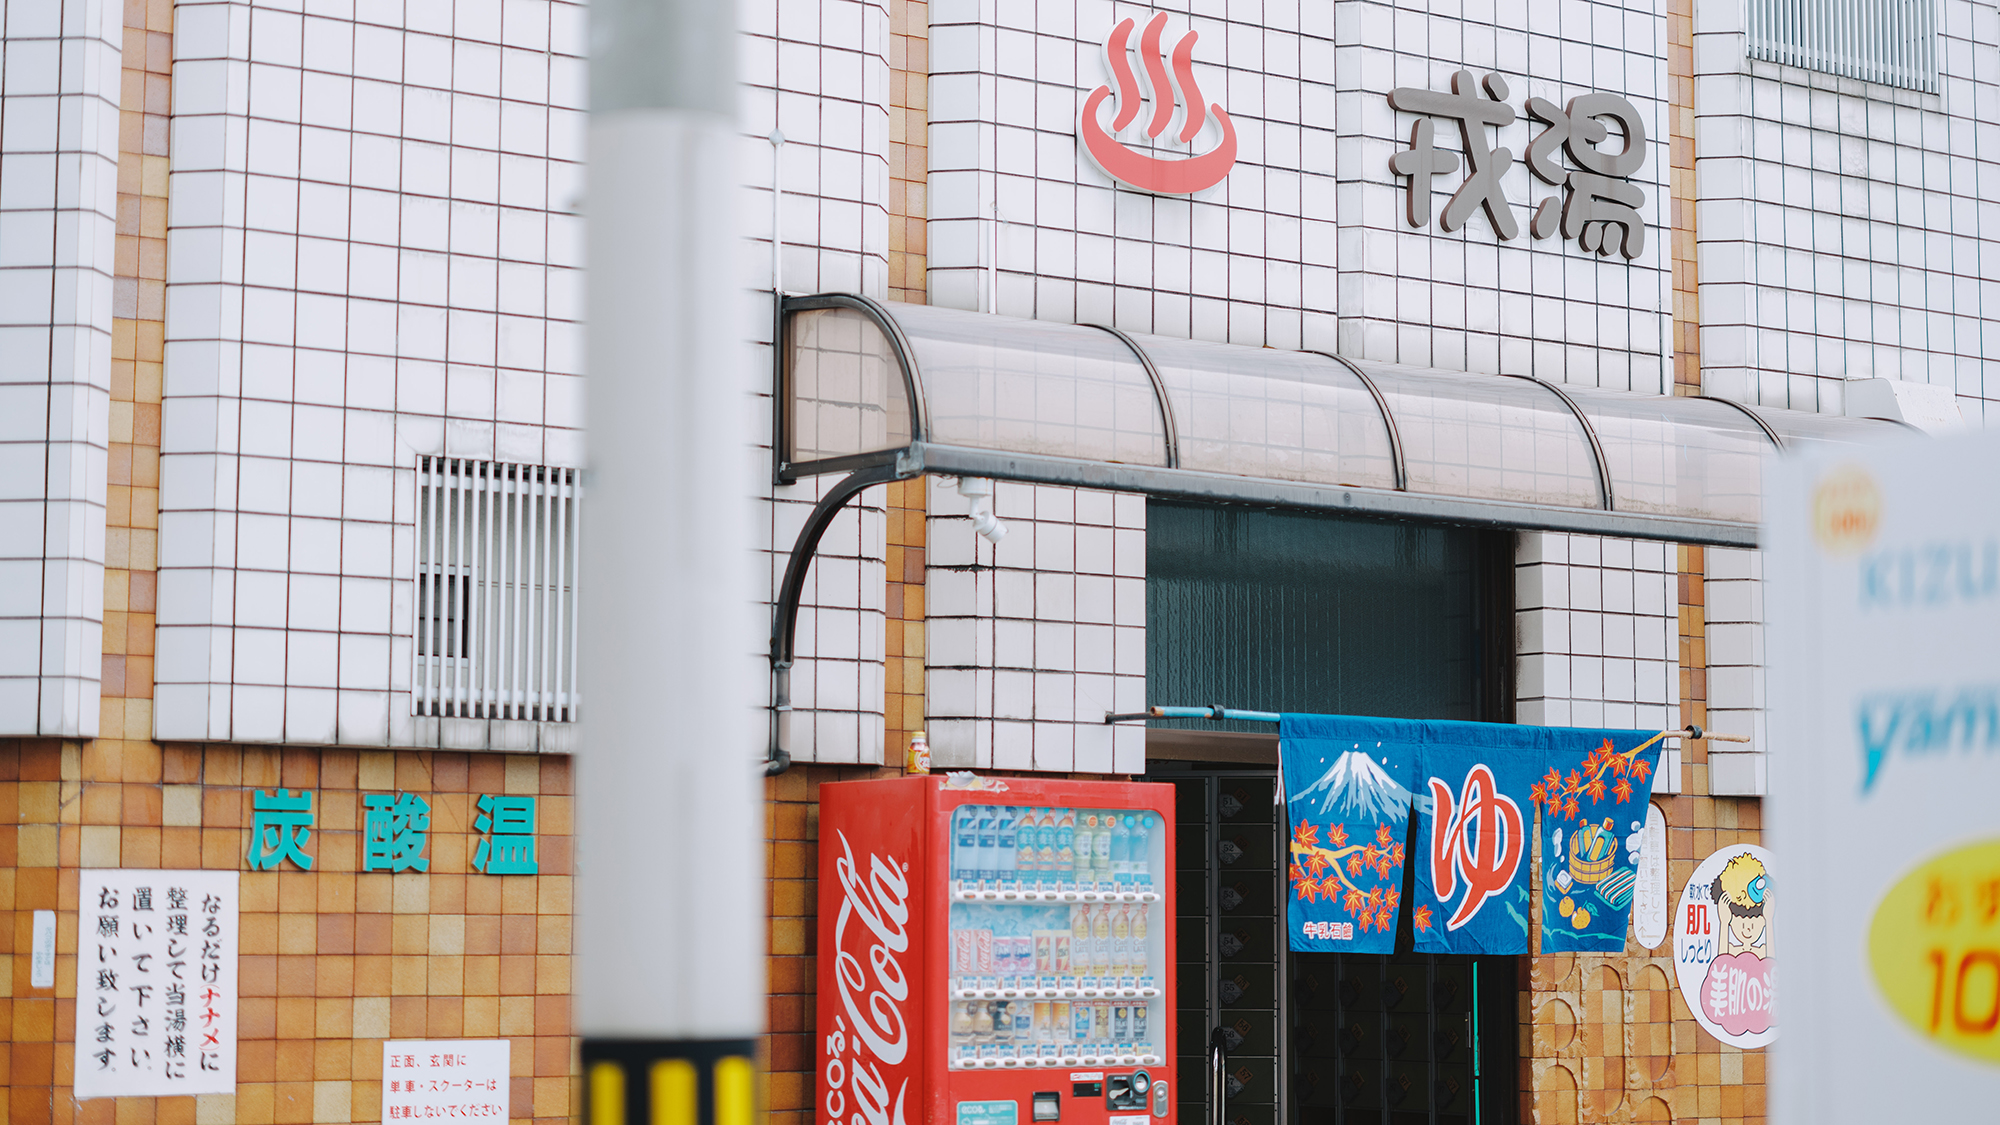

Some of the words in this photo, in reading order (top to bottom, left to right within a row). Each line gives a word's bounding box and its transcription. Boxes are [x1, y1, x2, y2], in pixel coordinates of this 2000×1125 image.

[1387, 69, 1646, 259] 戎湯
[246, 788, 538, 874] 炭酸温
[1428, 764, 1525, 931] ゆ
[1686, 904, 1711, 935] 肌
[1680, 938, 1712, 964] しっとり
[164, 887, 188, 1080] 整理して当湯横に
[390, 1054, 467, 1068] 正面、玄関に
[389, 1079, 497, 1093] 単車・スクーターは
[389, 1103, 503, 1119] 駐車しないでください
